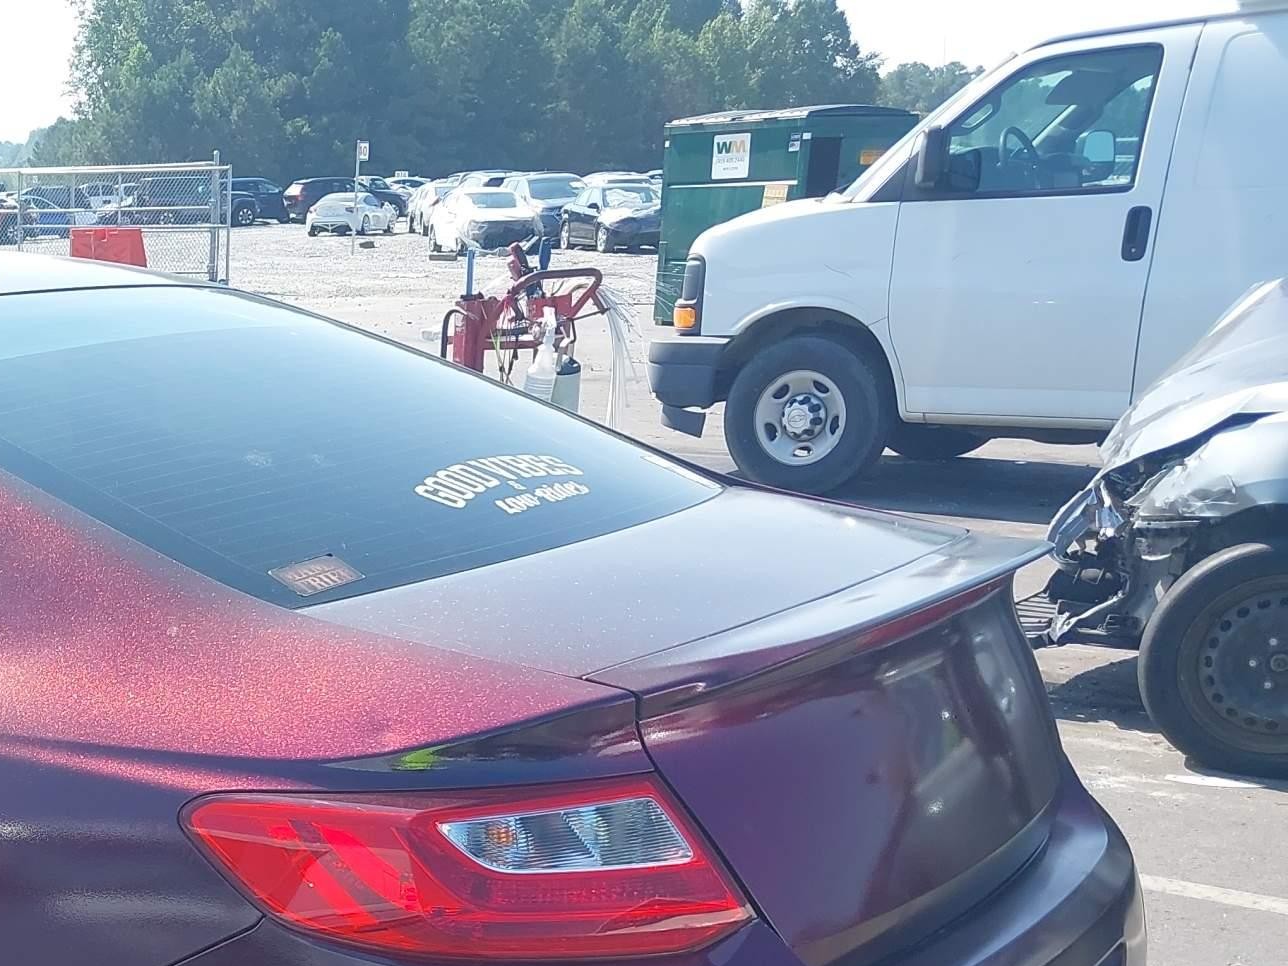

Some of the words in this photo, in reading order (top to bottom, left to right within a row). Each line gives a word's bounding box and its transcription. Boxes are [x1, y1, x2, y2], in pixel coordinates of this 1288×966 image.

[716, 140, 746, 154] WM
[414, 464, 501, 509] GOOD
[466, 454, 584, 480] VIBES
